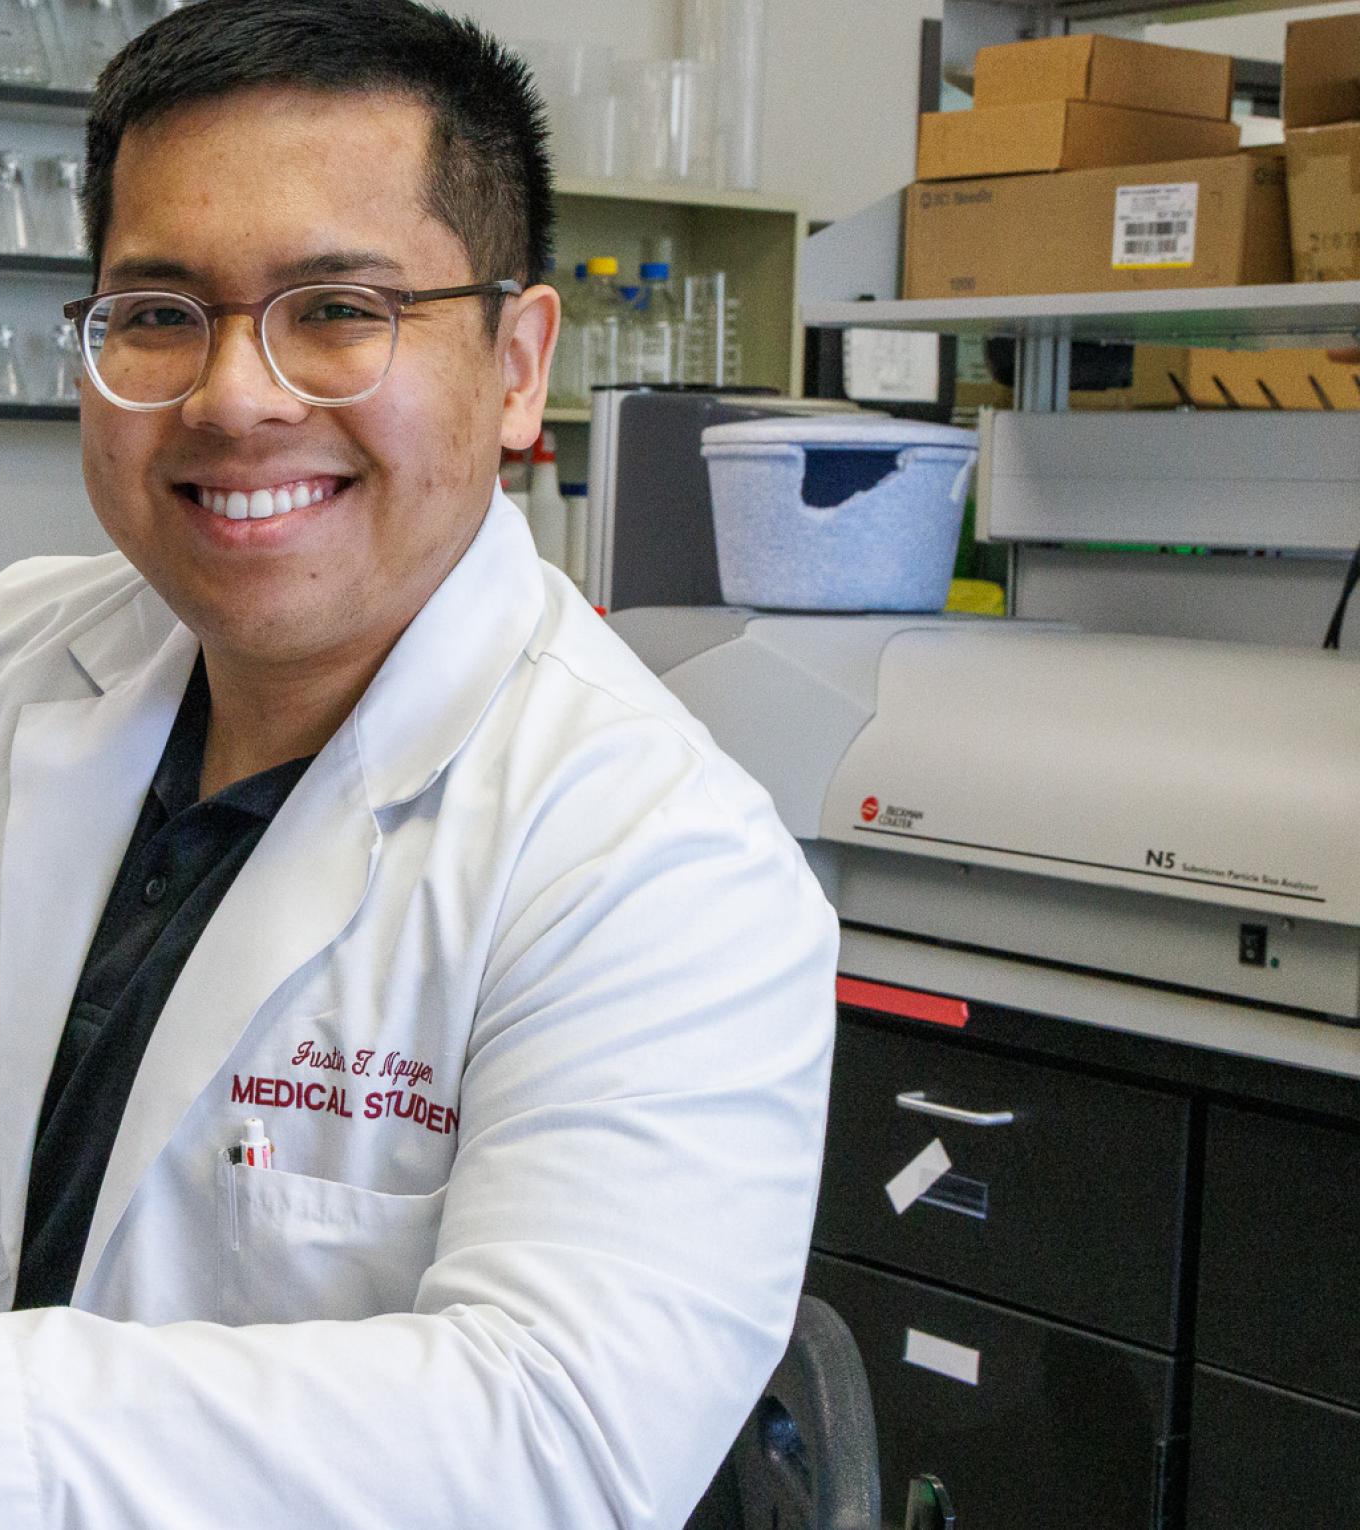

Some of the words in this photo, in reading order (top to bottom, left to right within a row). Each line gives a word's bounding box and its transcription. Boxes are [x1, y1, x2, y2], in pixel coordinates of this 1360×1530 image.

[1145, 849, 1176, 869] N5
[1227, 869, 1260, 883] Particle
[291, 1040, 347, 1073] Justin
[351, 1049, 376, 1078] T.
[231, 1074, 353, 1119] MEDICAL
